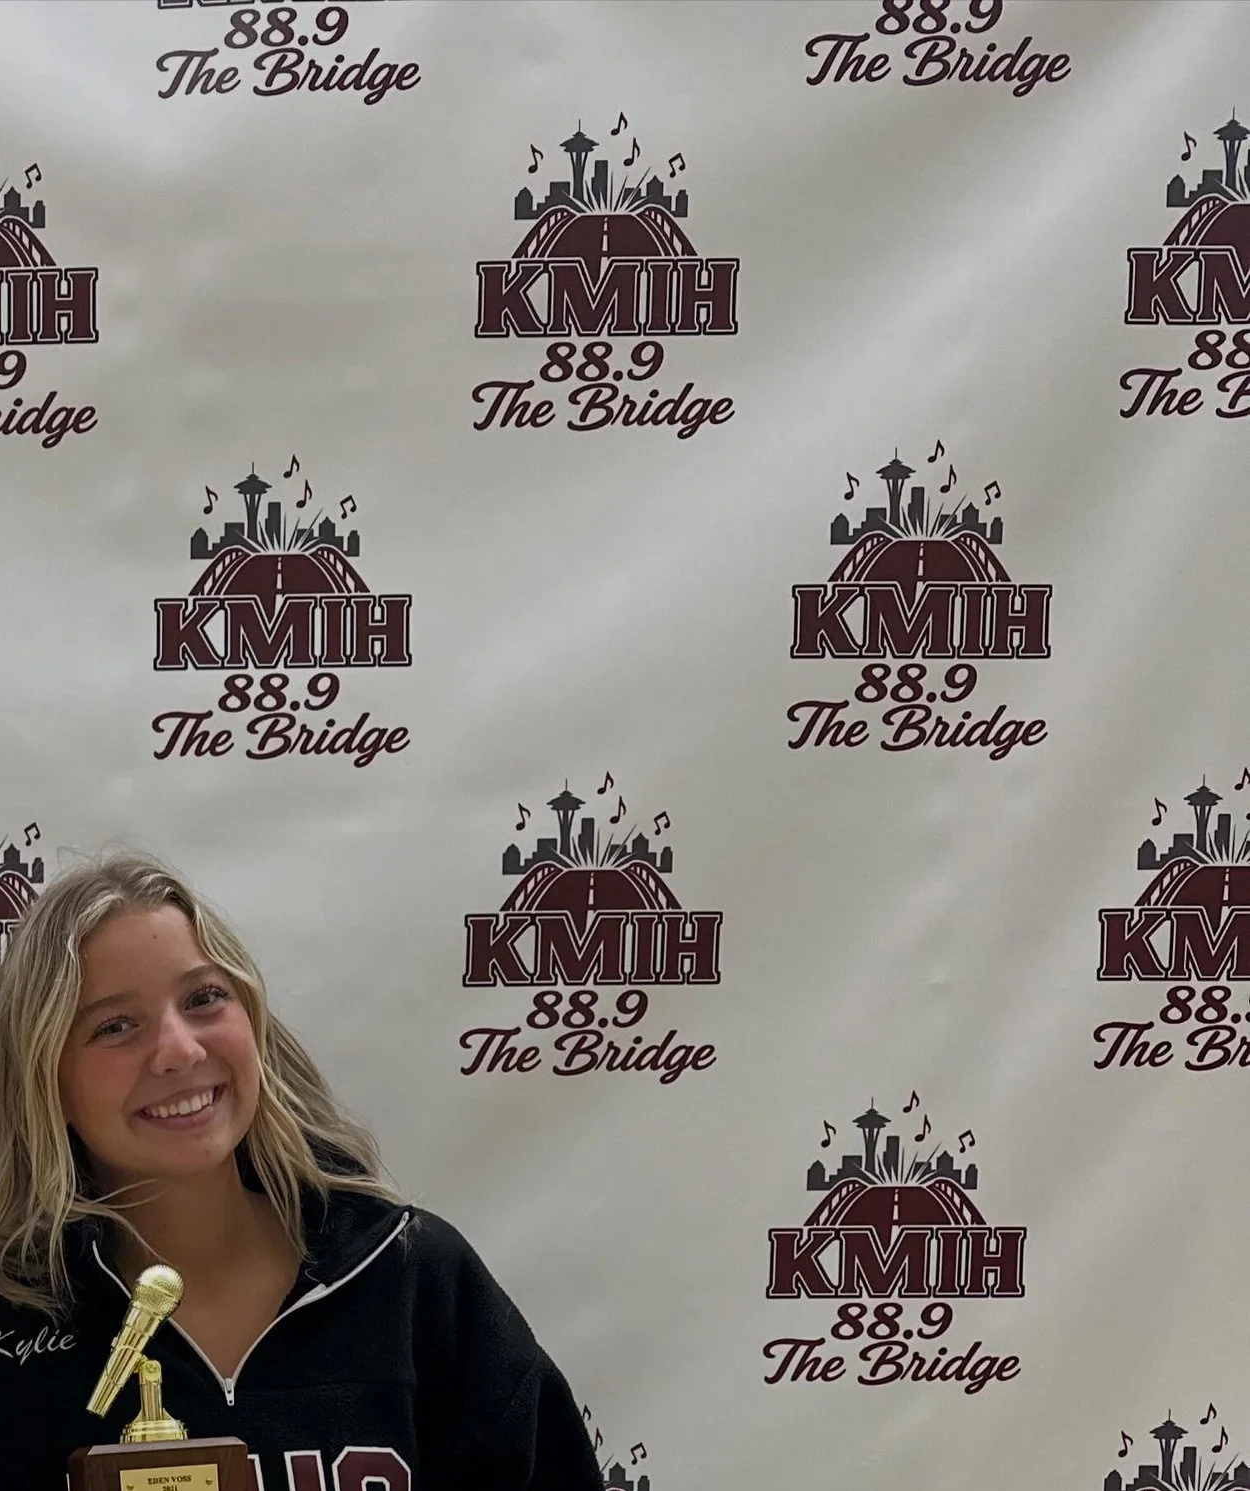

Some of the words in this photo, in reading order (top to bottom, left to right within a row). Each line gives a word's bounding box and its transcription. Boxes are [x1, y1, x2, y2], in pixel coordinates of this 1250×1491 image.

[224, 6, 349, 49] 88.9
[875, 0, 1003, 35] 88.9
[156, 48, 241, 99] The
[253, 48, 421, 105] Bridge
[805, 33, 891, 86] The
[903, 35, 1071, 97] Bridge
[474, 257, 740, 338] KMIH
[1124, 247, 1250, 325] KM
[540, 341, 664, 382] 88.9
[1188, 329, 1250, 370] 88
[472, 380, 556, 431] The
[567, 383, 735, 439] Bridge
[1120, 368, 1204, 418] The
[153, 594, 412, 671] KMIH
[790, 583, 1053, 659] KMIH
[218, 673, 340, 712] 88.9
[854, 663, 977, 703] 88.9
[152, 710, 234, 760] The
[246, 712, 410, 768] Bridge
[787, 700, 869, 749] The
[880, 704, 1048, 761] Bridge
[462, 911, 723, 988] KMIH
[1097, 908, 1250, 982] KM
[526, 989, 648, 1029] 88.9
[1159, 986, 1250, 1024] 88.
[460, 1026, 541, 1076] The
[553, 1029, 716, 1084] Bridge
[1093, 1021, 1174, 1069] The
[766, 1227, 1027, 1299] KMIH
[831, 1302, 953, 1340] 88.9
[763, 1337, 846, 1384] The
[857, 1341, 1021, 1395] Bridge
[147, 1476, 170, 1485] EDEN
[171, 1475, 192, 1483] VOSS
